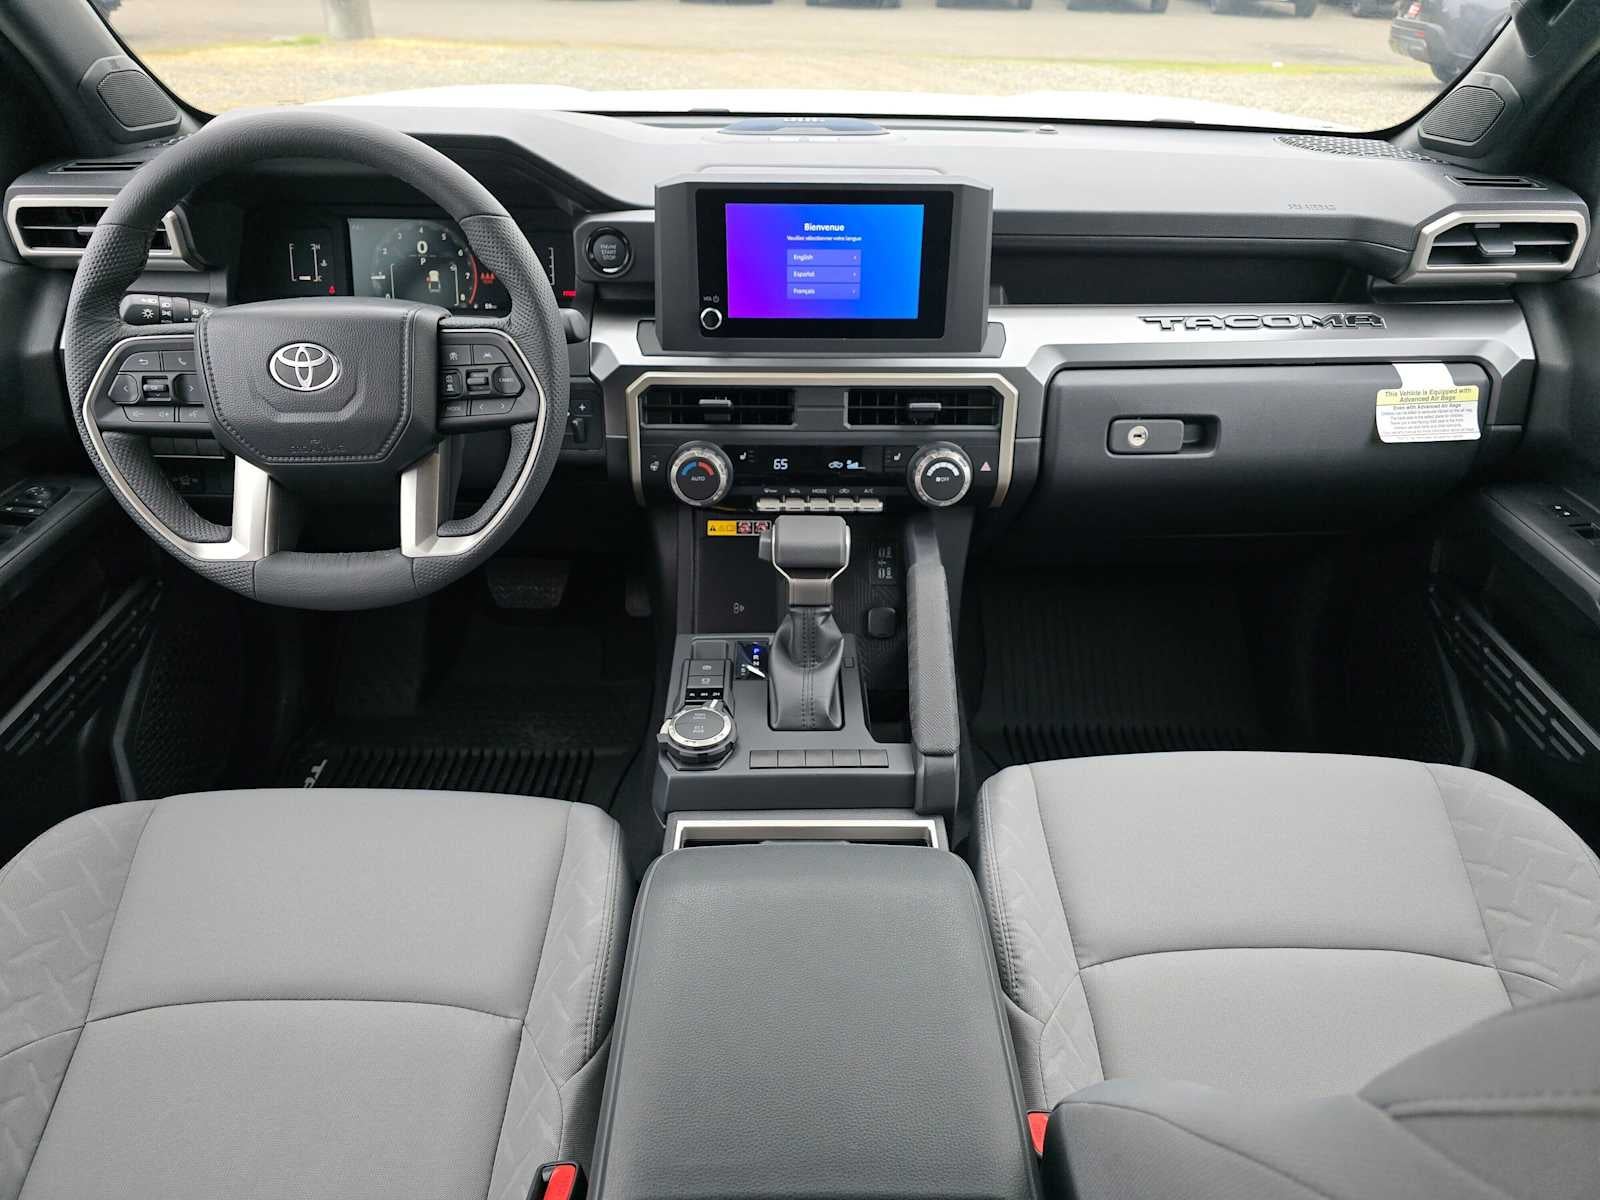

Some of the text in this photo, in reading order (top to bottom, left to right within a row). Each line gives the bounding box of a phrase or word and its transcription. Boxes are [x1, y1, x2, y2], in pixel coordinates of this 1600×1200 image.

[804, 223, 845, 231] Bienvenue
[416, 240, 428, 254] 0
[793, 253, 814, 261] English
[1137, 312, 1387, 332] TACOMA
[1400, 389, 1421, 397] Vehicle
[1429, 388, 1458, 397] Equipped
[773, 458, 789, 470] 65
